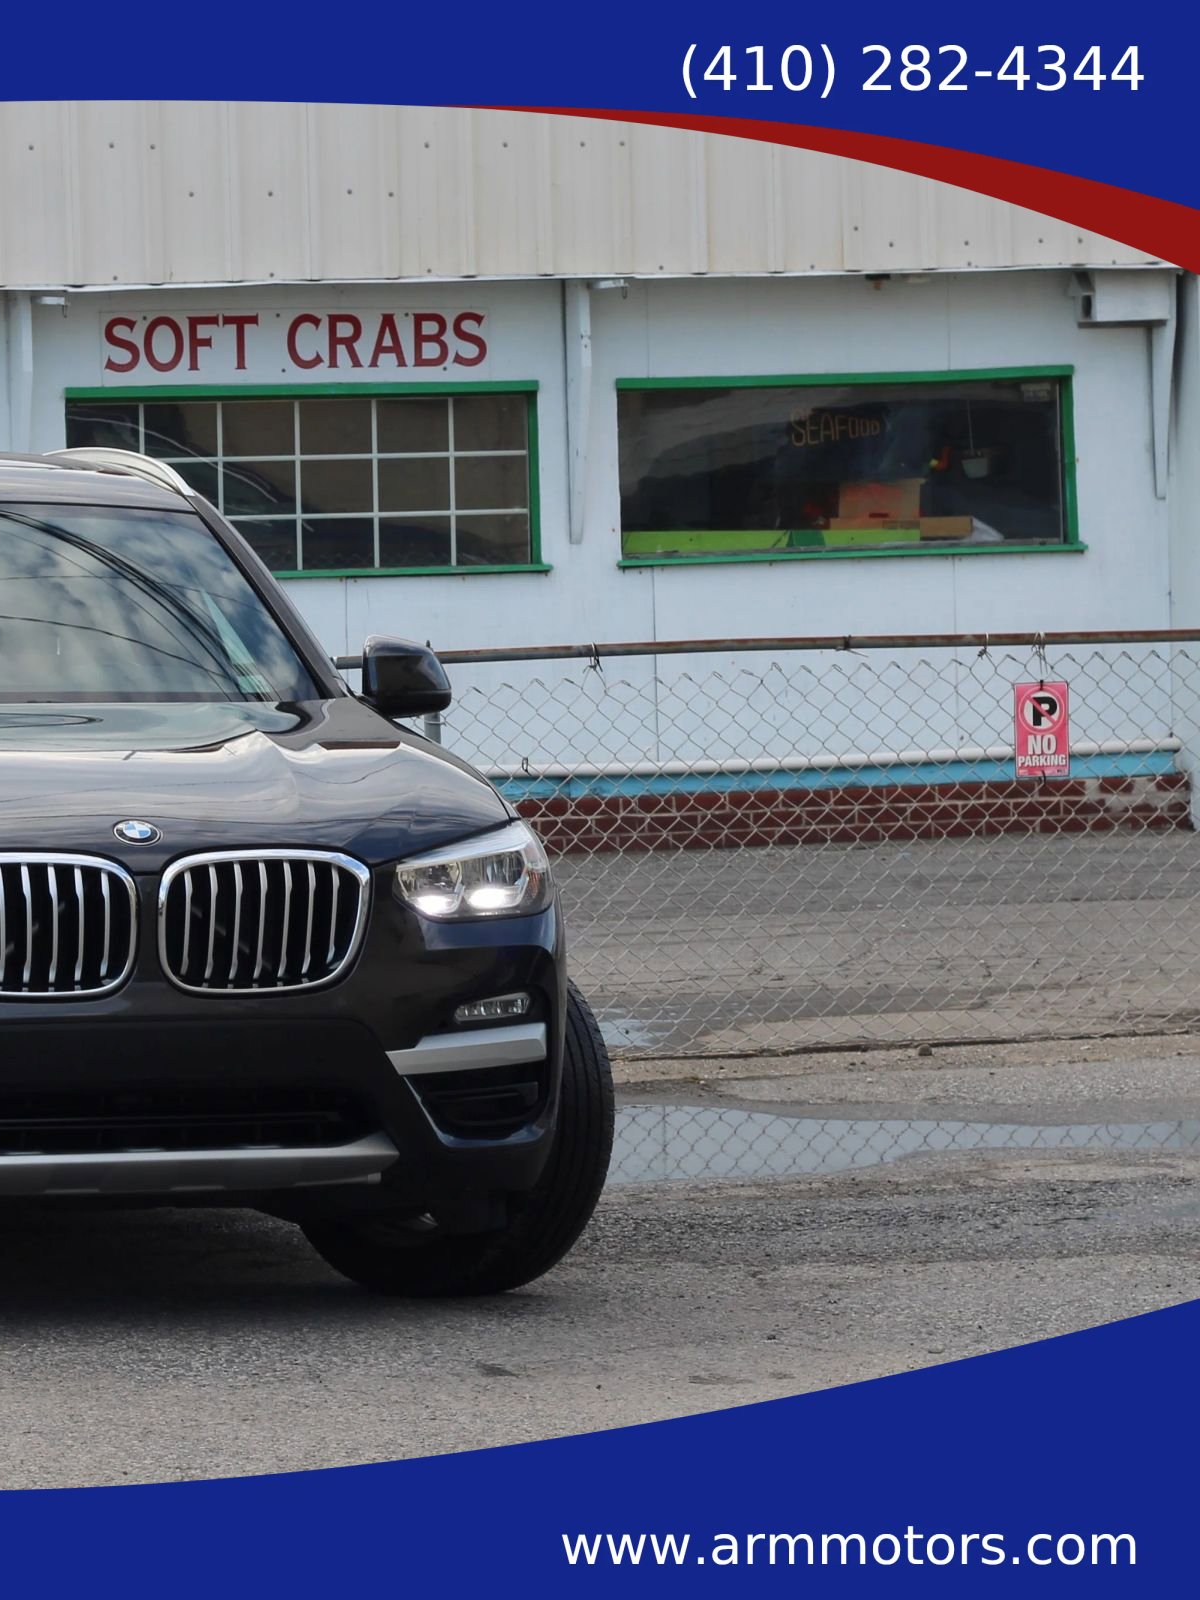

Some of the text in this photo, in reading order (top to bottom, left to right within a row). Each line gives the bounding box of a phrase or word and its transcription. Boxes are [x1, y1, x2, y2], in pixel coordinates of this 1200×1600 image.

[104, 312, 488, 373] SOFT CRABS
[1027, 733, 1057, 755] NO
[1018, 753, 1067, 768] PARKING
